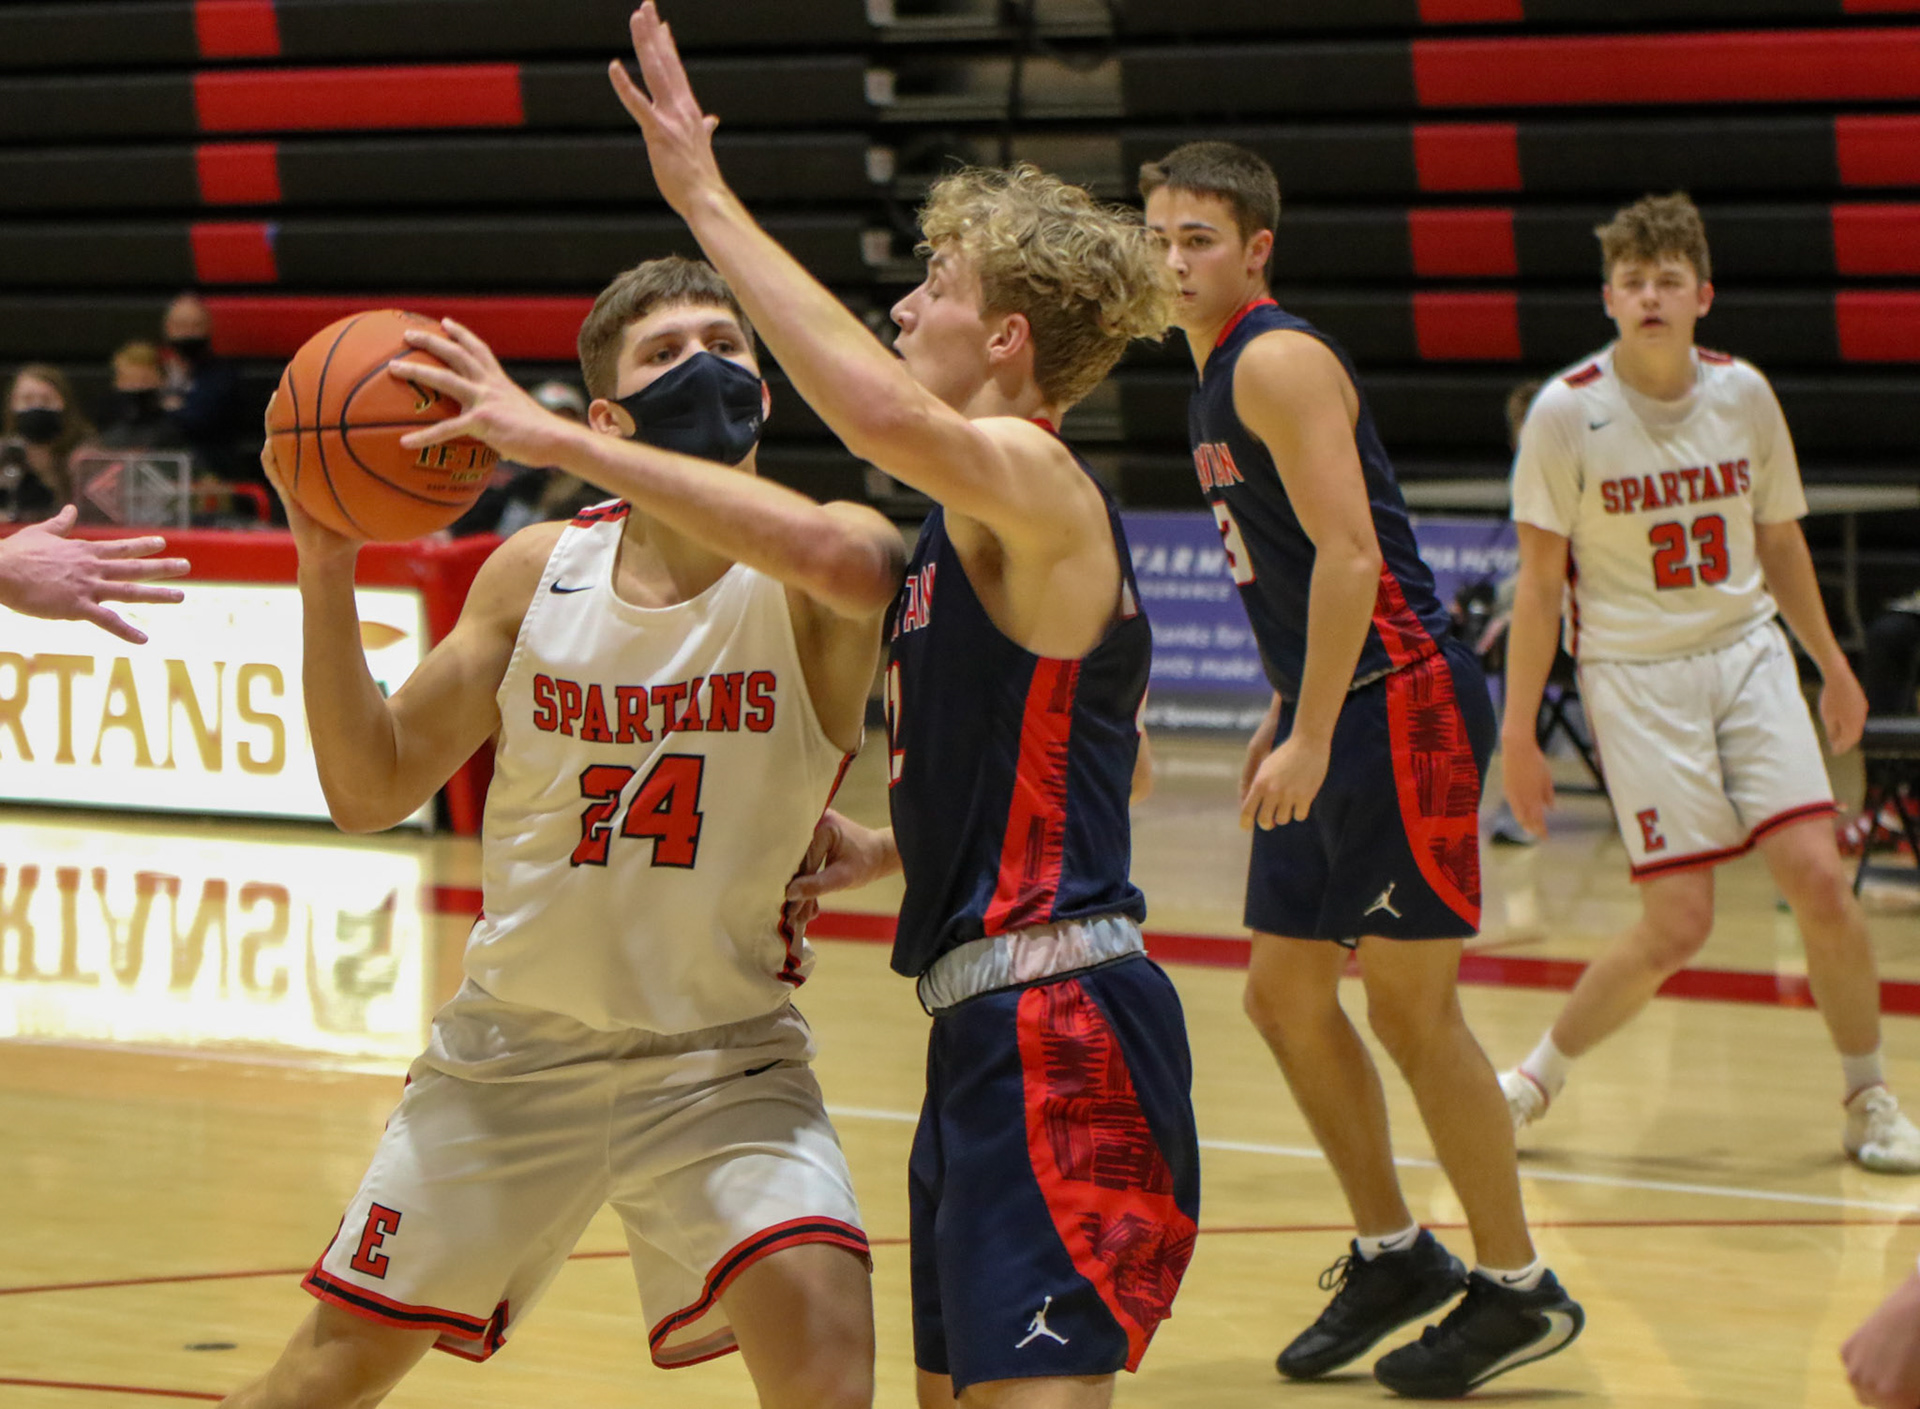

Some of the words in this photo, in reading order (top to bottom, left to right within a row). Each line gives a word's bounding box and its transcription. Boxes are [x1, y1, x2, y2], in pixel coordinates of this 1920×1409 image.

[1601, 458, 1751, 514] SPARTANS
[1648, 512, 1731, 591] 23
[533, 671, 777, 743] SPARTANS
[570, 753, 706, 869] 24
[1636, 807, 1666, 854] E
[350, 1201, 402, 1280] E
